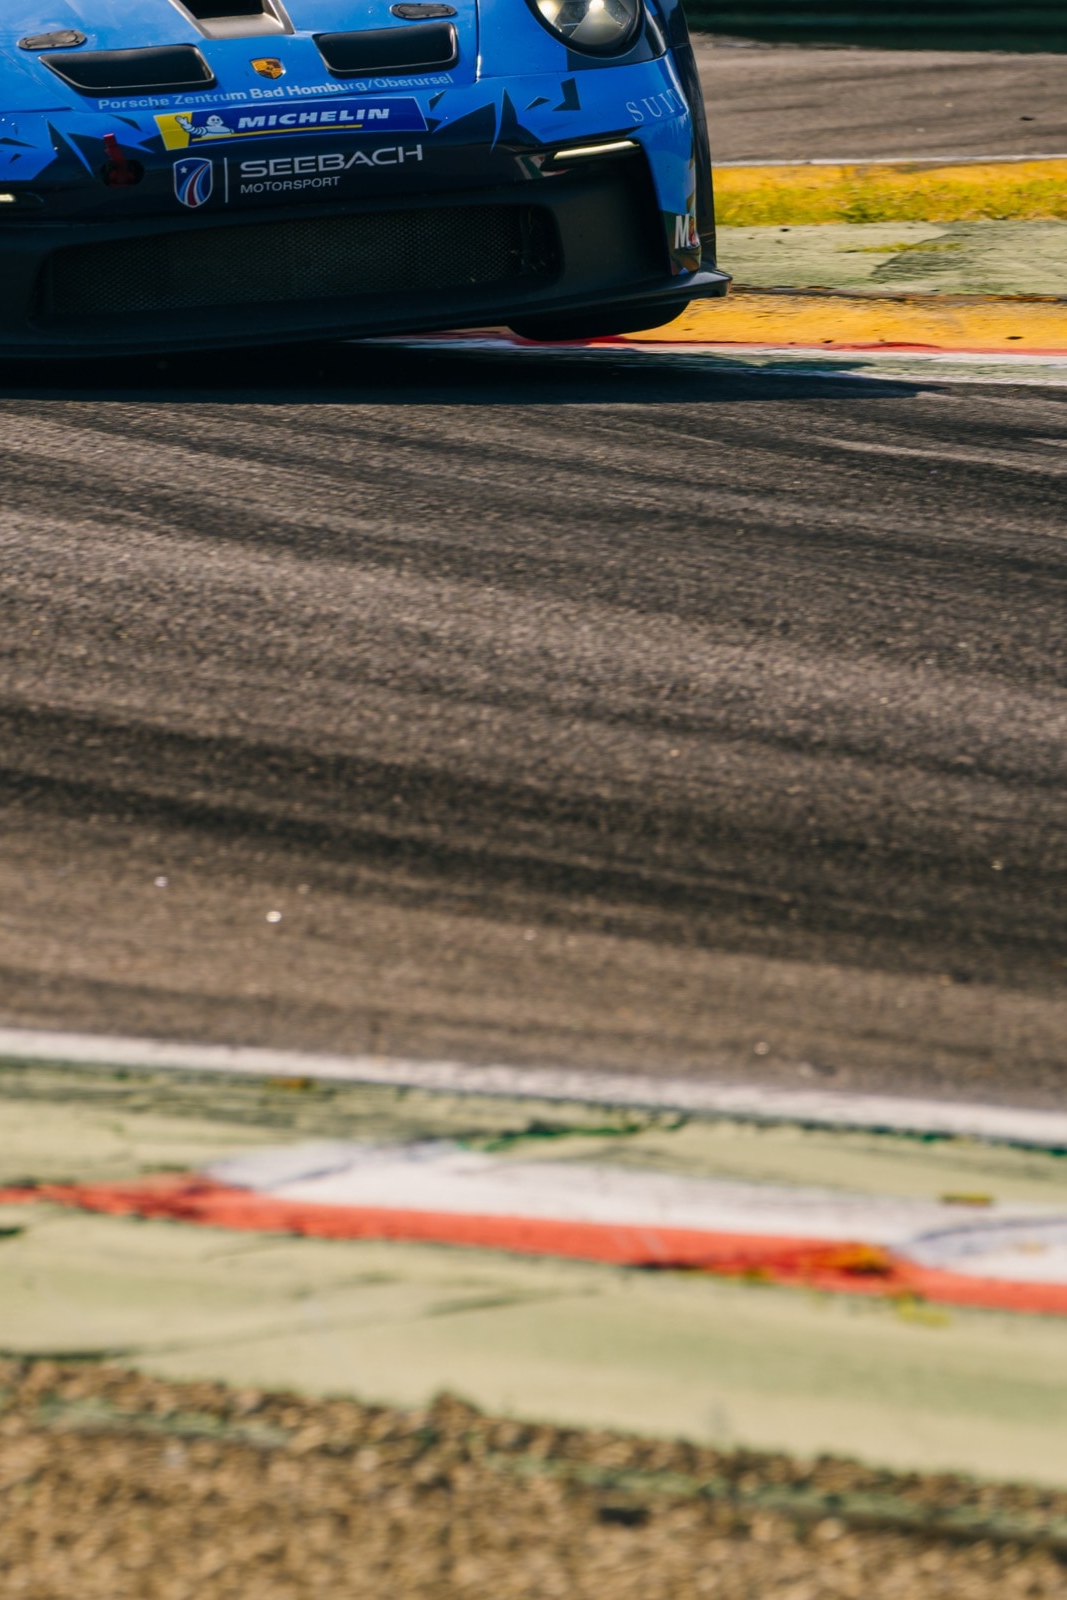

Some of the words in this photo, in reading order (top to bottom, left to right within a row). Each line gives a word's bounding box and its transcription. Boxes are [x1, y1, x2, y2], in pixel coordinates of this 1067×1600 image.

[97, 96, 170, 110] Porsche
[173, 89, 248, 106] Zentrum
[251, 86, 284, 100] Bad
[238, 108, 390, 129] MICHELIN
[240, 144, 423, 178] SEEBACH
[240, 176, 341, 194] MOTORSPORT
